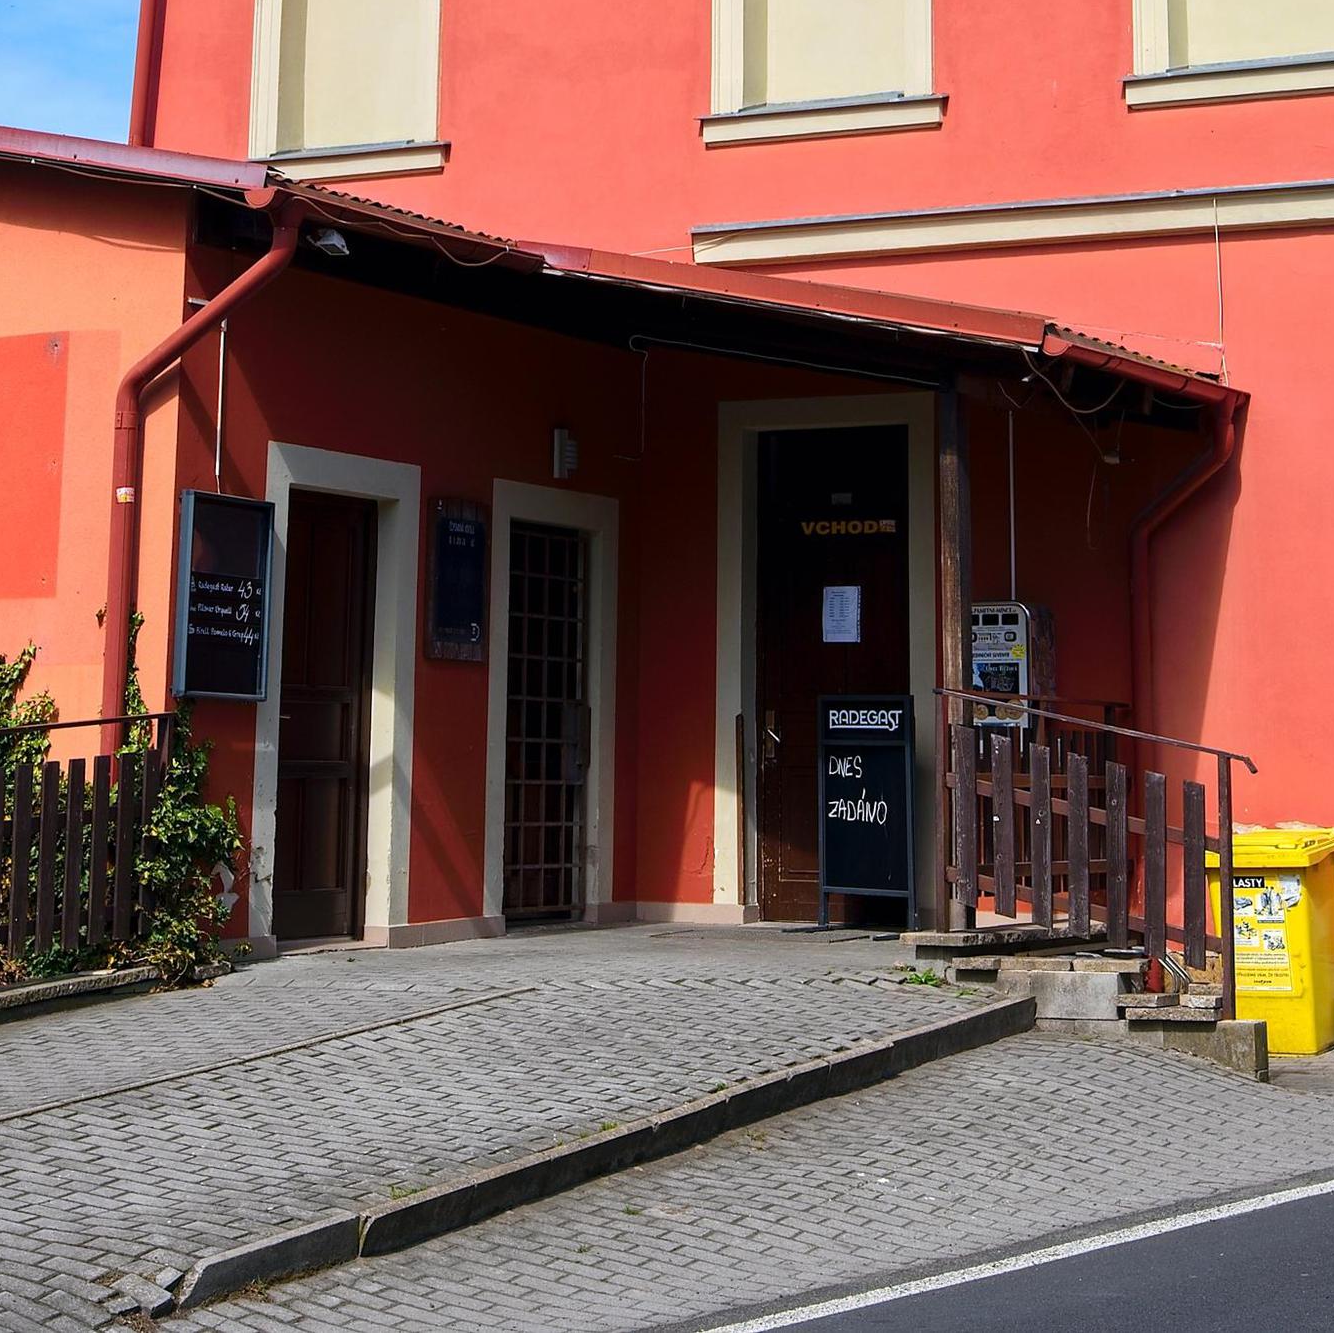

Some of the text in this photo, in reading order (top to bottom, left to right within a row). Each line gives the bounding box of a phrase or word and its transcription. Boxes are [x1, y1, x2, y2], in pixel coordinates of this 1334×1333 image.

[801, 520, 878, 535] VCHOD
[237, 580, 253, 599] 43
[829, 709, 903, 732] RADEGAST
[828, 755, 863, 778] DNES
[827, 787, 888, 825] ZADÁNO
[1233, 878, 1263, 888] LASTY
